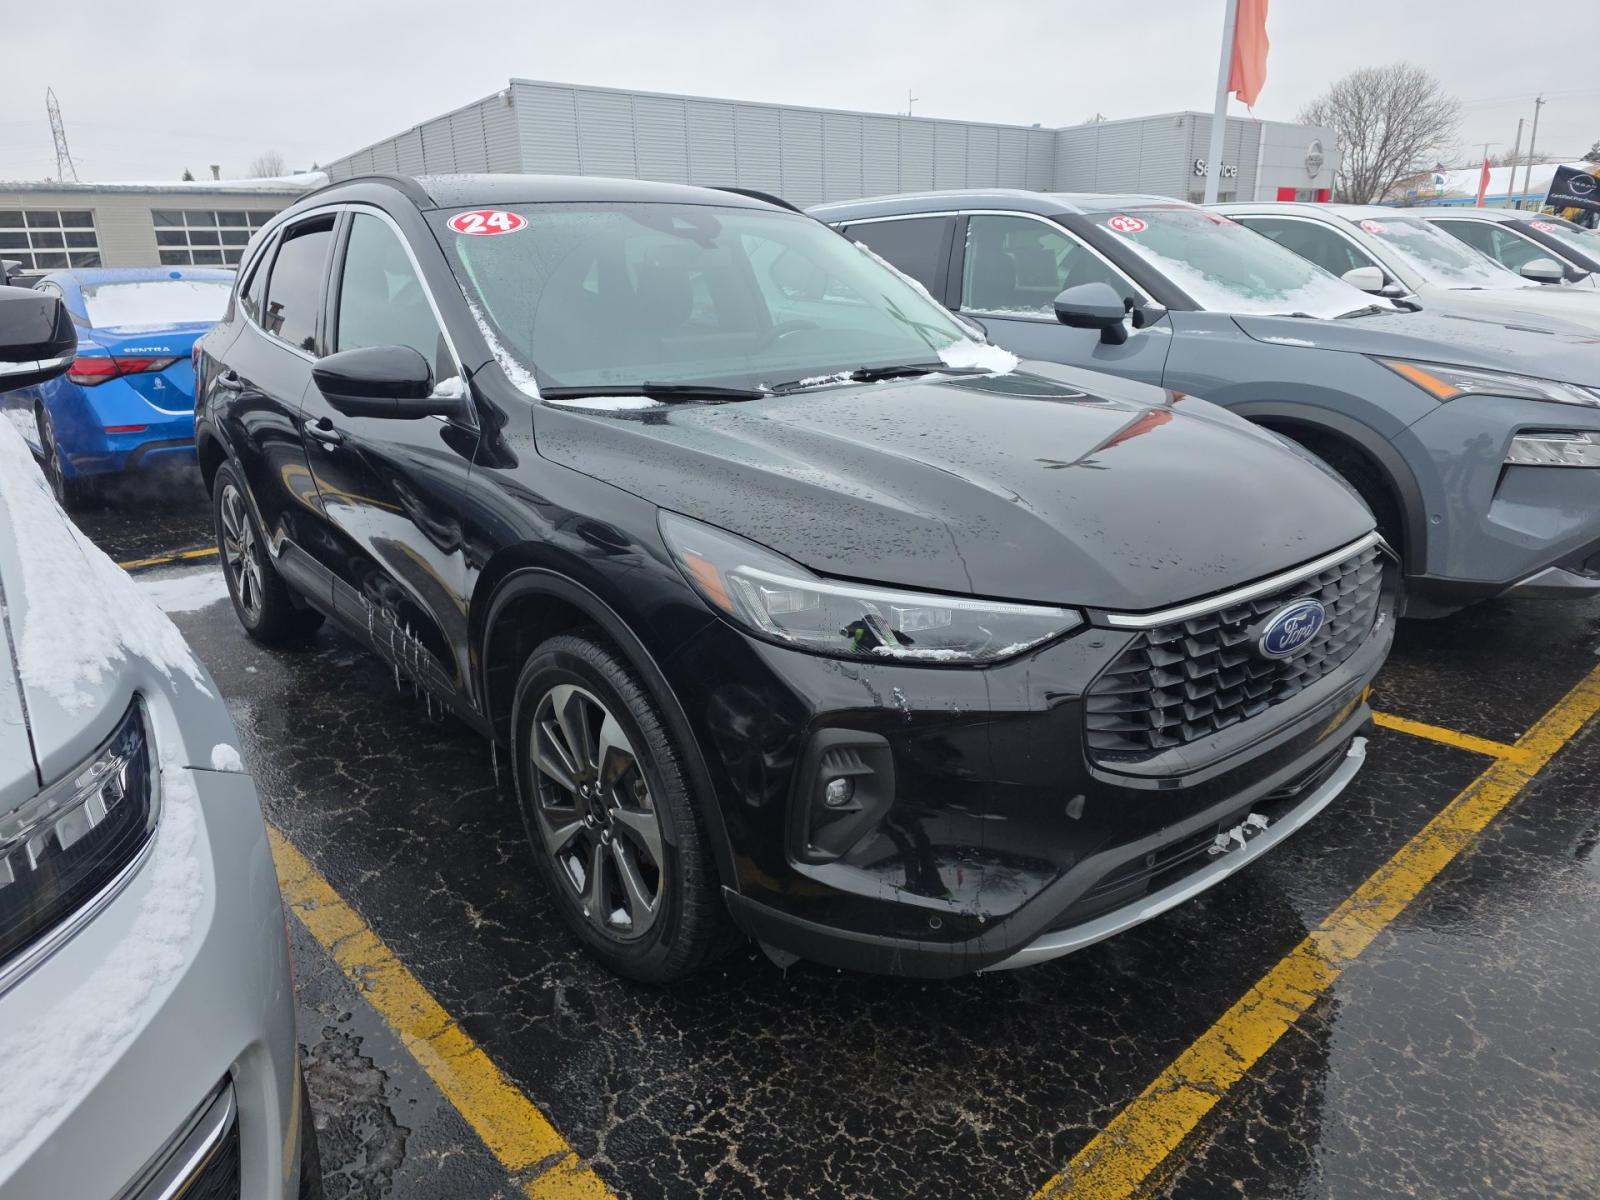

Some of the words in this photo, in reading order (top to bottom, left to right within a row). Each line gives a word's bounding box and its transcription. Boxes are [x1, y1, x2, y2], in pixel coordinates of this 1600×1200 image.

[1194, 159, 1238, 177] Seice
[460, 212, 513, 234] 24
[123, 346, 171, 354] SENTRA
[1279, 612, 1316, 649] Ford
